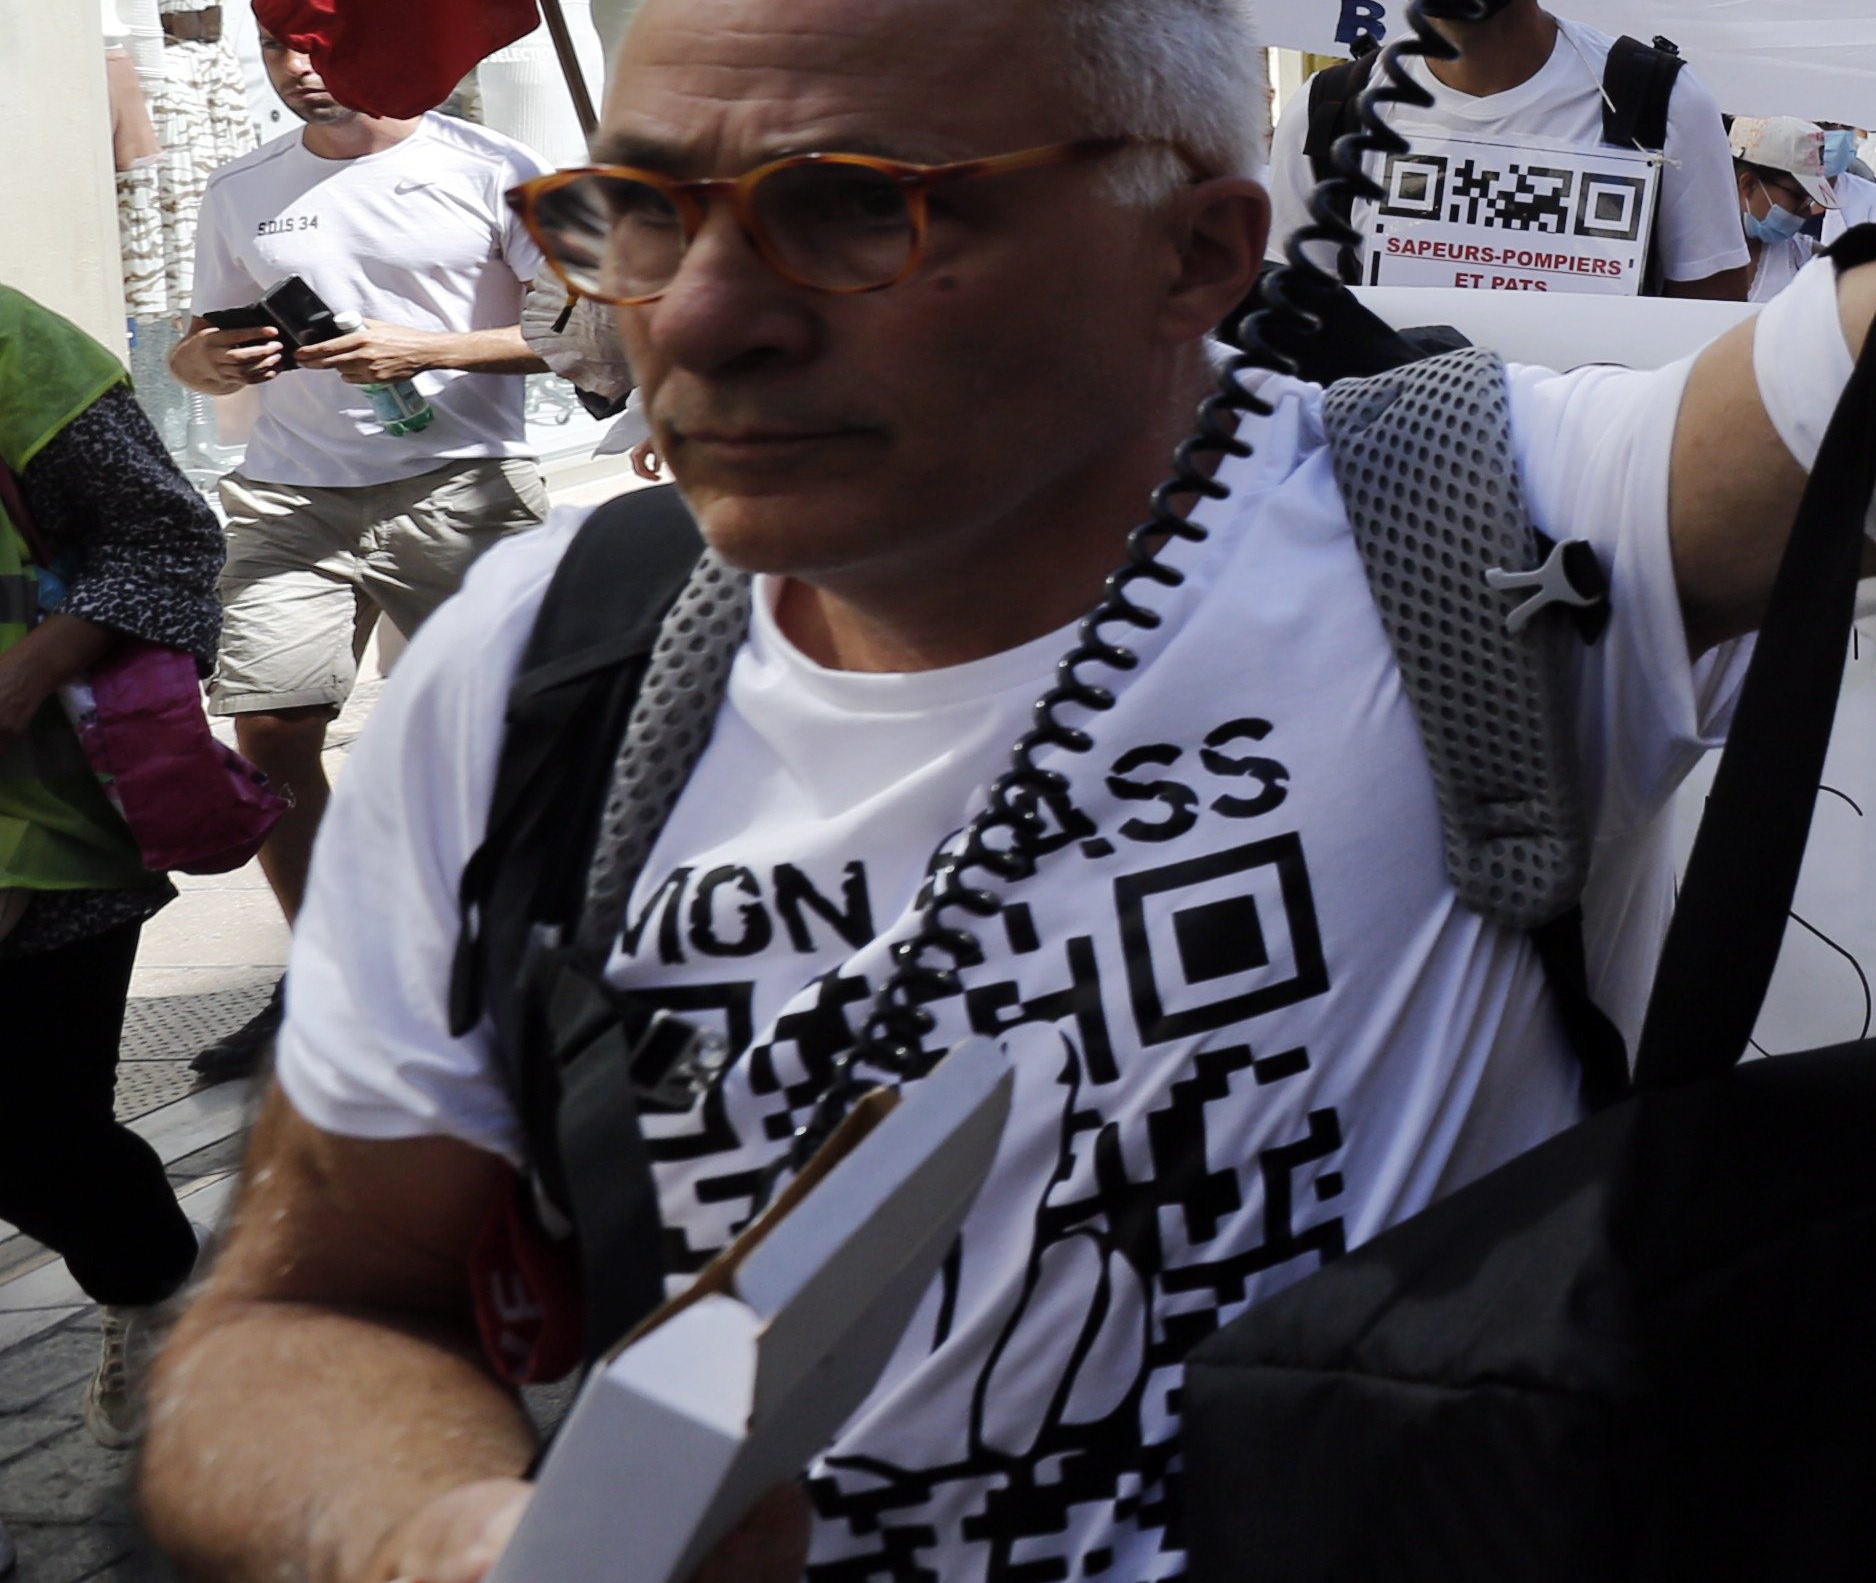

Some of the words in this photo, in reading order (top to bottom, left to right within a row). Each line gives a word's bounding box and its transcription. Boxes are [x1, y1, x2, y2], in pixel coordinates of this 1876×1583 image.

[299, 214, 319, 232] 34
[1386, 236, 1622, 276] SAPEURS-POMPIERS
[1454, 272, 1485, 289] ET
[1490, 275, 1548, 293] PATS
